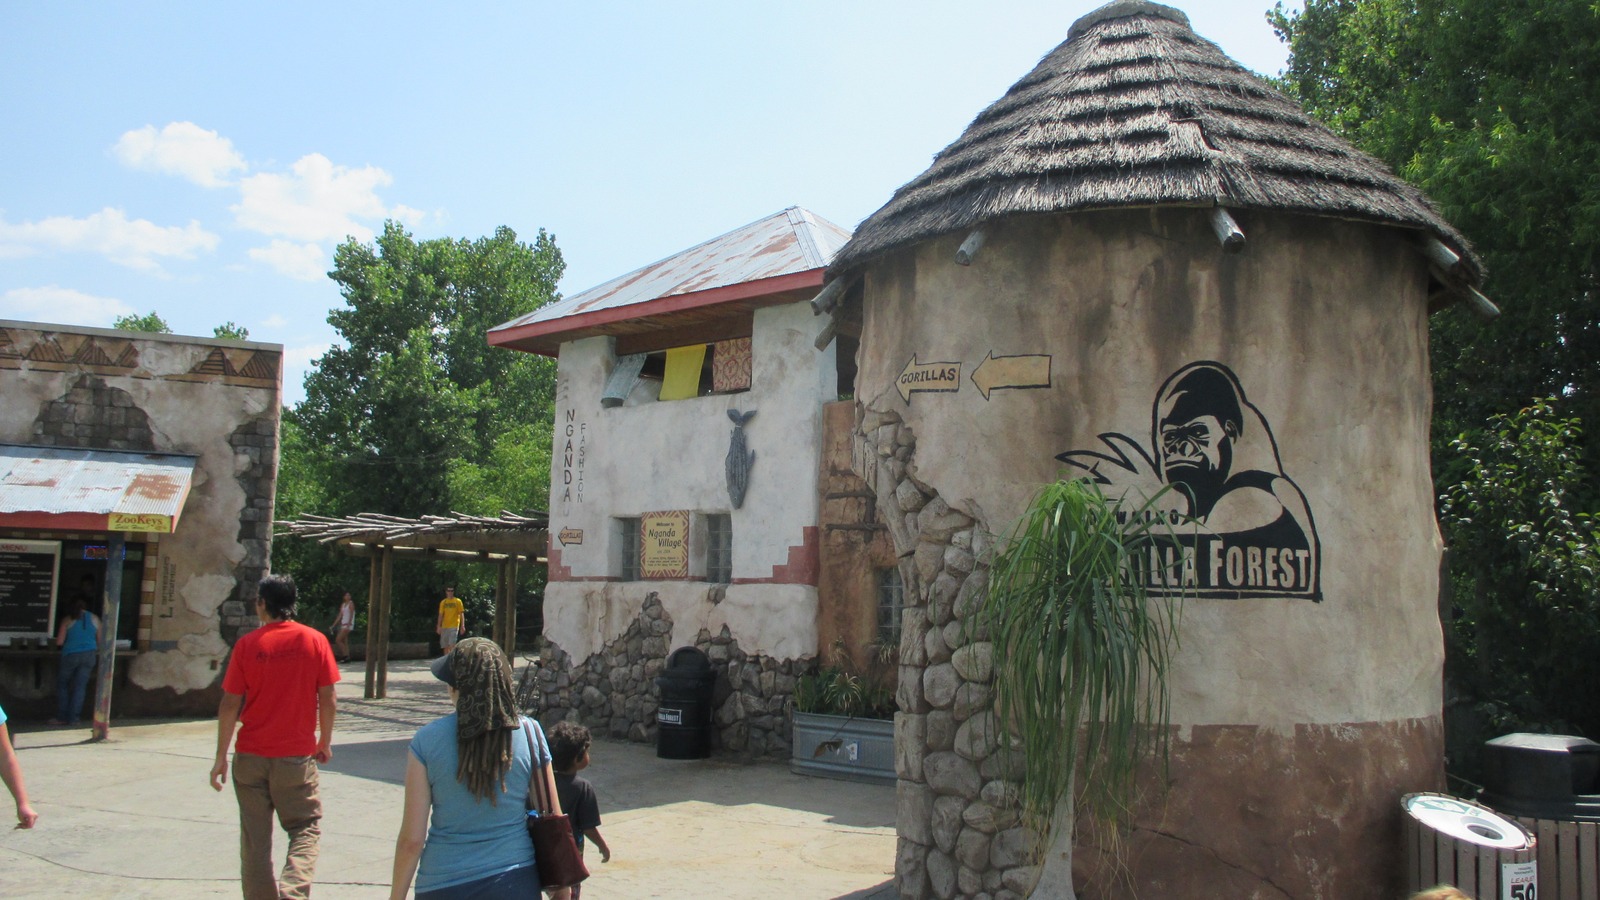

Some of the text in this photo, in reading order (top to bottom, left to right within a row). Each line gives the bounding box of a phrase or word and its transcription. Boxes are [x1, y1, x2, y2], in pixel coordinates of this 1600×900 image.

[901, 367, 956, 384] GORILLAS
[563, 408, 575, 502] NGANDA
[577, 422, 587, 503] FASHION
[115, 514, 163, 526] ZooKeys
[648, 528, 676, 539] Nganda
[658, 538, 682, 549] Village
[1209, 539, 1309, 588] FOREST
